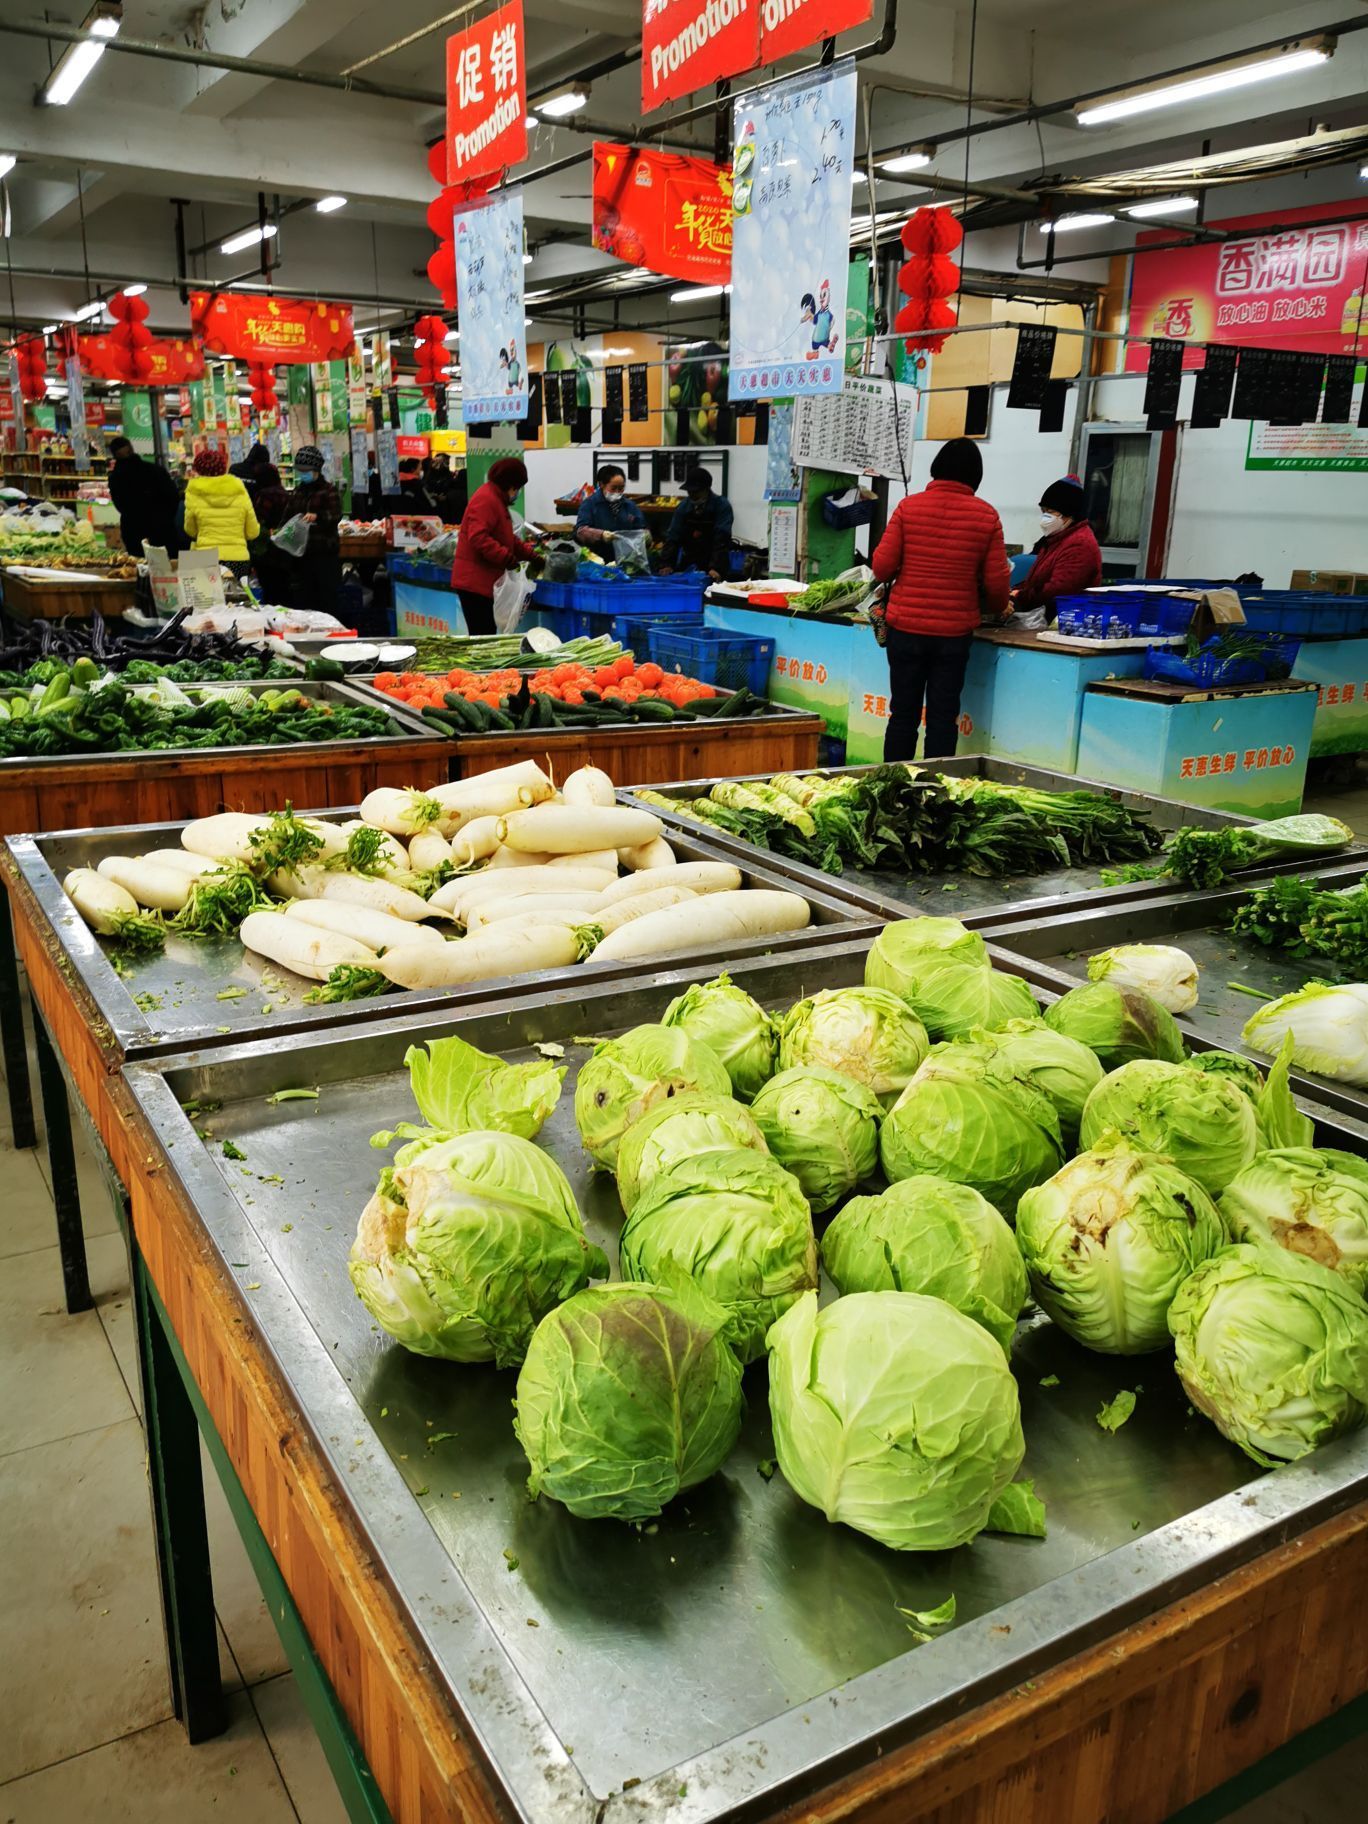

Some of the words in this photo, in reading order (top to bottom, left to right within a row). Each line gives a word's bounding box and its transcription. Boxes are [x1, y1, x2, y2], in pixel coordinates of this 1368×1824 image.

[455, 22, 518, 110] 促销
[454, 91, 521, 169] Promotion
[1217, 228, 1347, 293] 香满园
[1164, 298, 1194, 338] 香
[1217, 300, 1269, 326] 放心油
[1271, 295, 1327, 322] 放心米
[775, 655, 828, 684] 平价放心
[1180, 751, 1238, 779] 天惠生鲜
[1243, 744, 1296, 772] 平价放心
